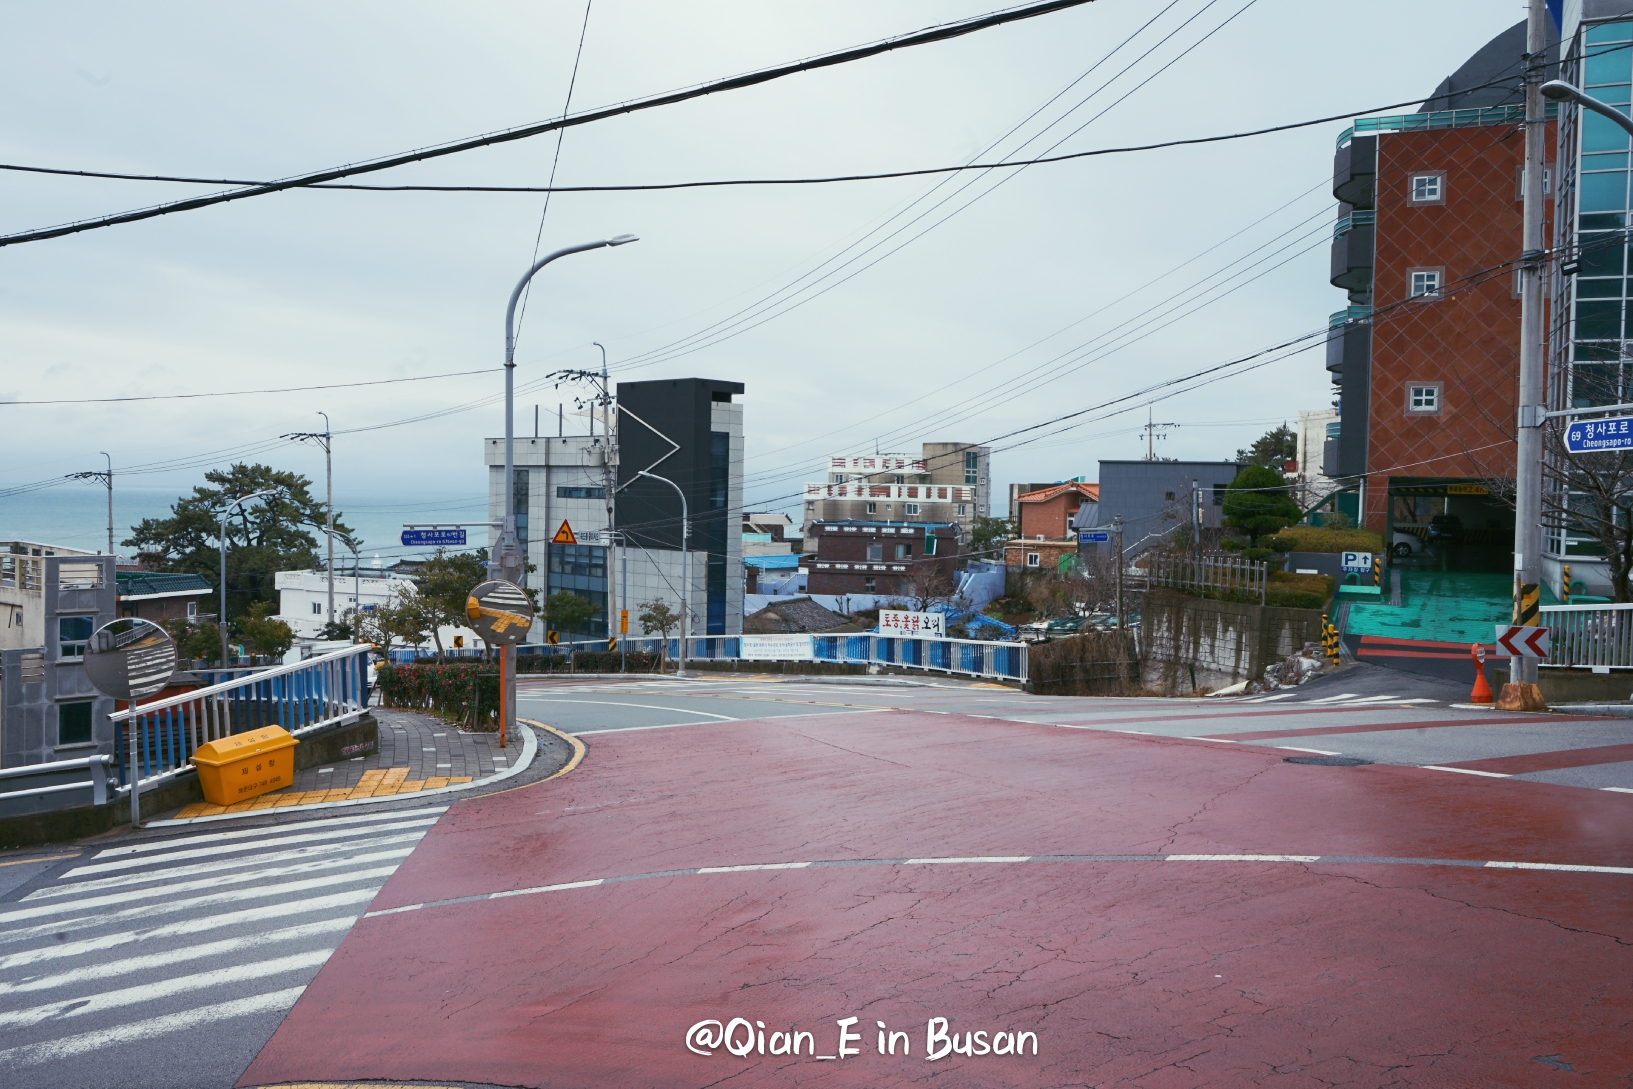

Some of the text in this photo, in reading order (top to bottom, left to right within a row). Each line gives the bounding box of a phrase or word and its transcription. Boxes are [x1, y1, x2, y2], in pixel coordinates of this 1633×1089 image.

[1571, 431, 1581, 441] 69
[1585, 421, 1629, 439] 청사포로
[1582, 438, 1632, 448] Cheongsapo-ro
[1344, 553, 1357, 566] P
[921, 616, 940, 632] 오리
